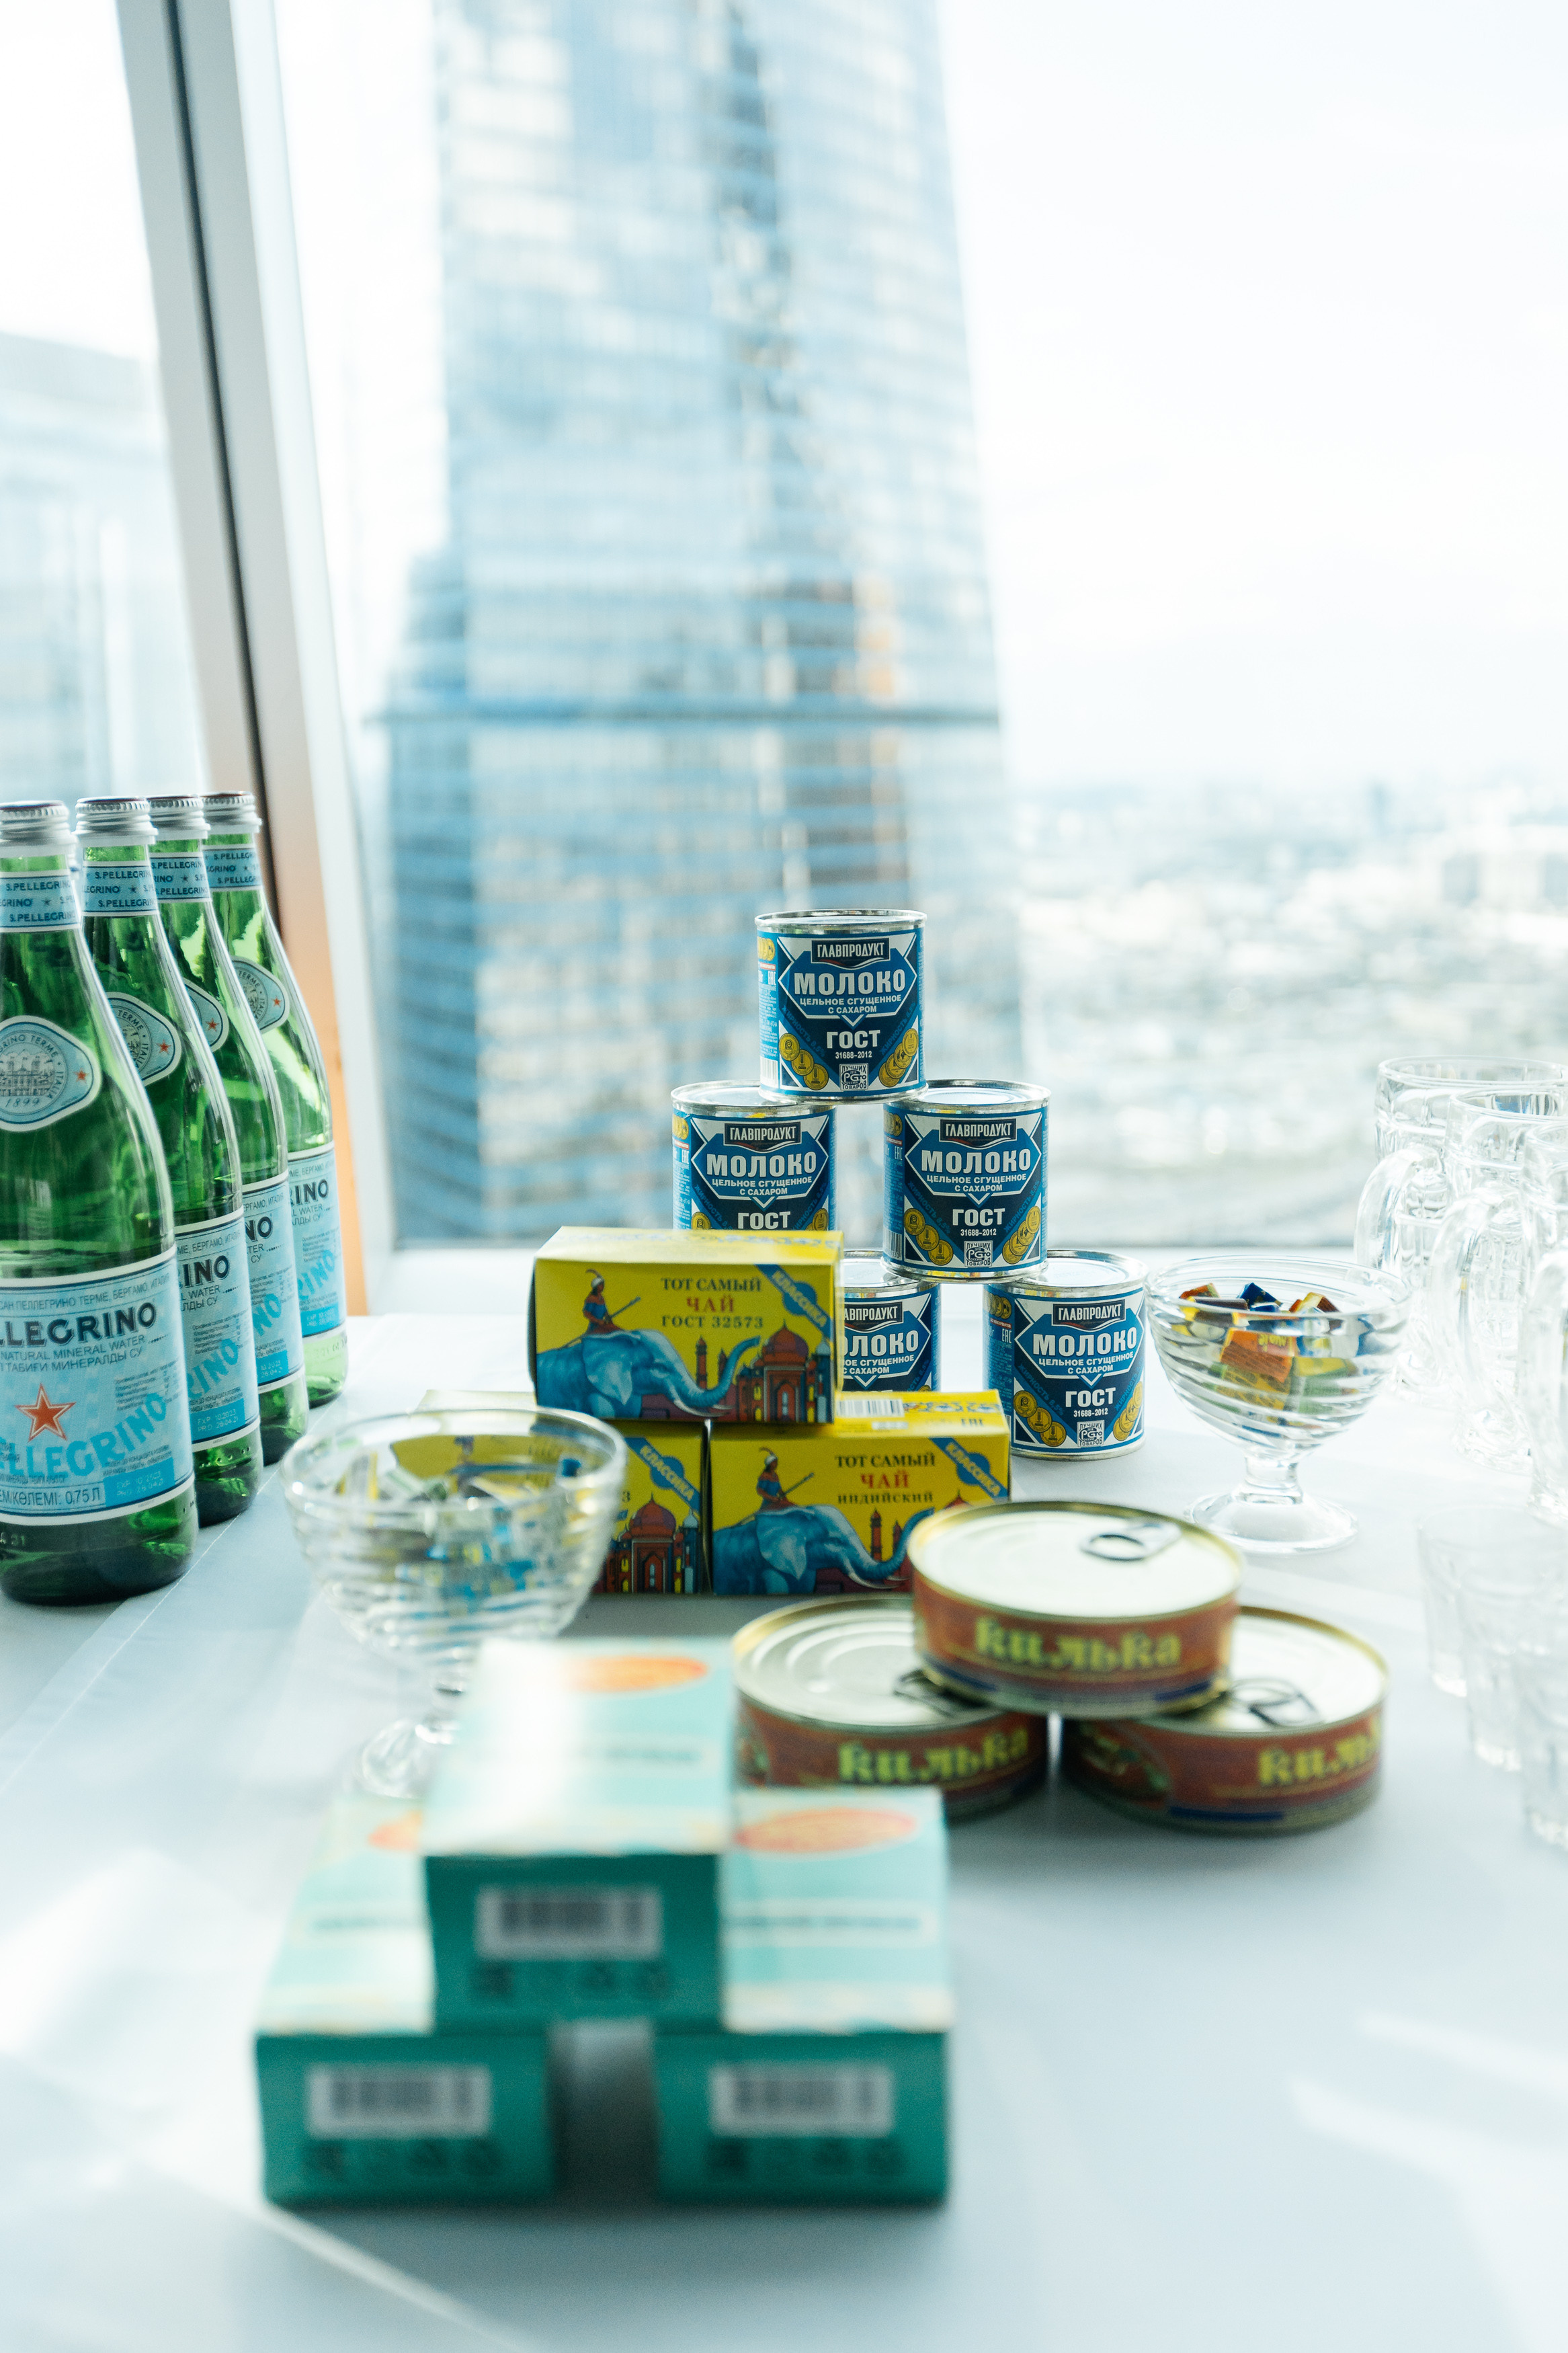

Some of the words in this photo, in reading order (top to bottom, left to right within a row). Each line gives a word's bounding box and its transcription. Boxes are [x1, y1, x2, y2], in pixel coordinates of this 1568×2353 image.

[817, 943, 884, 958] ГЛАВПРОДУКТ
[239, 970, 260, 988] TERME
[794, 969, 905, 996] МОЛОКО
[800, 998, 844, 1006] ЦЕЛЬНОЕ
[847, 994, 901, 1006] СГУЩЕННОЕ
[836, 1006, 876, 1014] САХАРОМ
[118, 1010, 144, 1031] TERME
[782, 1005, 811, 1042] ЖИРНОСТЬ
[827, 1030, 880, 1049] ГОСТ
[880, 1018, 907, 1055] ЖИРНОСТЬ
[31, 1035, 58, 1058] TERME
[835, 1051, 872, 1060] 31688-2012
[841, 1065, 866, 1074] ЛУЧШИХ
[46, 1071, 64, 1099] ITALIA
[841, 1080, 866, 1089] ТОВАРОВ
[5, 1097, 40, 1107] 1899
[730, 1126, 796, 1140] ГЛАВПРОДУКТ
[946, 1123, 1012, 1137] ГЛАВПРОДУКТ
[895, 1146, 903, 1160] EAC
[706, 1152, 817, 1177] МОЛОКО
[921, 1148, 1031, 1174] МОЛОКО
[712, 1179, 755, 1187] ЦЕЛЬНОЕ
[758, 1176, 812, 1187] СГУЩЕННОЕ
[927, 1175, 971, 1183] ЦЕЛЬНОЕ
[974, 1173, 1026, 1184] СГУЩЕННОЕ
[747, 1187, 788, 1195] САХАРОМ
[694, 1184, 723, 1222] ЖИРНОСТЬ
[908, 1181, 936, 1218] ЖИРНОСТЬ
[299, 1203, 323, 1215] WATER
[794, 1199, 817, 1230] ИРНОСТЬ
[952, 1207, 1005, 1226] ГОСТ
[1003, 1196, 1032, 1232] ЖИРНОСТЬ
[313, 1213, 321, 1222] СУ
[737, 1211, 791, 1230] ГОСТ
[960, 1228, 997, 1236] 31688-2012
[251, 1254, 262, 1263] СУ
[966, 1257, 991, 1266] ТОВАРОВ
[661, 1277, 693, 1291] ТОТ
[696, 1276, 761, 1292] САМЫЙ
[188, 1285, 220, 1299] WATER
[772, 1270, 827, 1327] КЛАССИКА
[16, 1295, 77, 1310] ПЕЛЛЕГРИНО
[207, 1295, 218, 1306] СУ
[686, 1295, 735, 1312] ЧАЙ
[844, 1306, 898, 1321] АВПРОДУКТ
[1058, 1304, 1122, 1320] ГЛАВПРОДУКТ
[0, 1302, 157, 1349] LEGRINO
[661, 1315, 705, 1328] ГОСТ
[712, 1315, 764, 1328] 32573
[1002, 1328, 1012, 1343] EAC
[1033, 1326, 1137, 1357] МОЛОКО
[0, 1349, 51, 1361] NATURAL
[53, 1345, 106, 1360] MINERAL
[110, 1334, 145, 1351] WATER
[844, 1330, 919, 1357] ЛОКО
[51, 1350, 127, 1371] МИНЕРАЛДЫ
[130, 1347, 143, 1359] СУ
[860, 1355, 914, 1366] СГУЩЕННОЕ
[1038, 1357, 1083, 1366] ЦЕЛЬНОЕ
[1086, 1352, 1134, 1366] СГУЩЕННОЕ
[849, 1367, 889, 1375] САХАРОМ
[1075, 1364, 1113, 1373] САХАРОМ
[1018, 1363, 1049, 1400] ЖИРНОСТЬ
[1065, 1387, 1116, 1407] ГОСТ
[1114, 1373, 1137, 1411] ЖИРНОСТЬ
[1073, 1408, 1108, 1417] 31688-2012
[1079, 1423, 1102, 1431] ЛУЧШИХ
[1079, 1437, 1102, 1445] ТОВАРОВ
[835, 1454, 868, 1468] ТОТ
[871, 1452, 936, 1467] САМЫЙ
[640, 1445, 695, 1501] КЛАССИКА
[946, 1441, 1001, 1497] КЛАССИКА
[860, 1470, 909, 1489] ЧАЙ
[91, 1488, 101, 1502] Л
